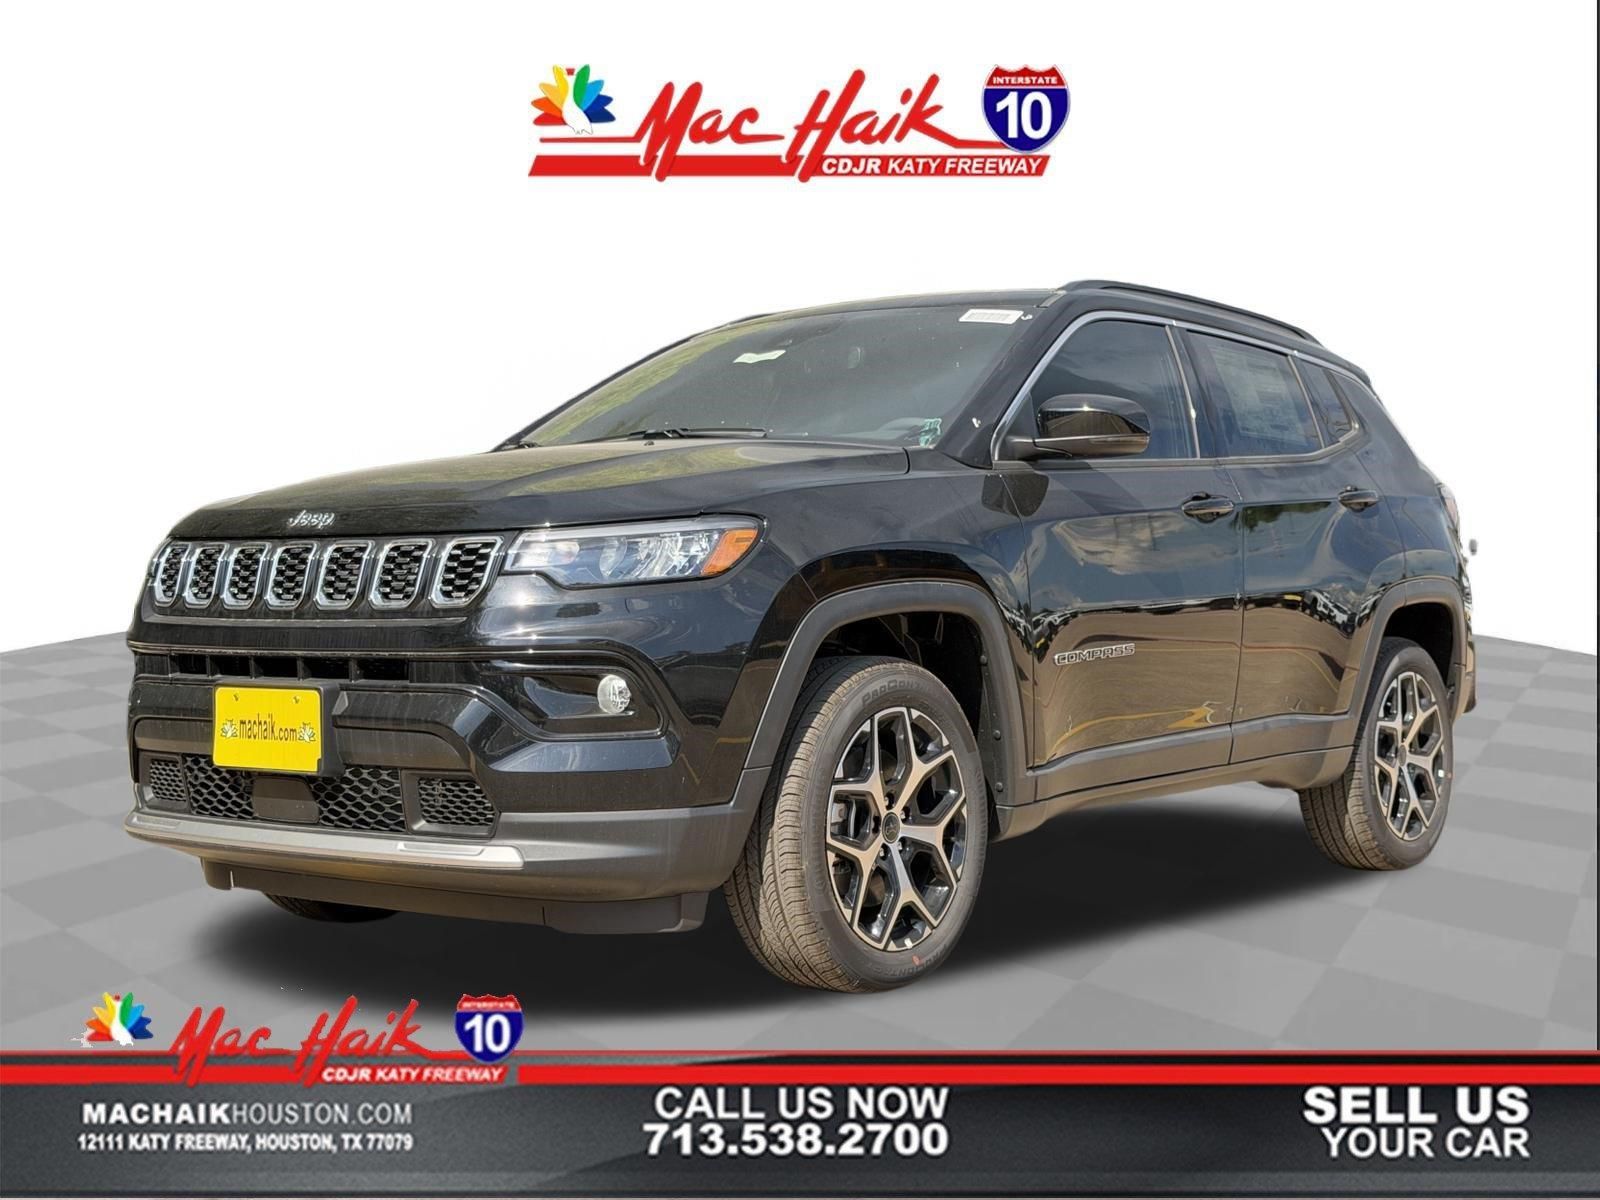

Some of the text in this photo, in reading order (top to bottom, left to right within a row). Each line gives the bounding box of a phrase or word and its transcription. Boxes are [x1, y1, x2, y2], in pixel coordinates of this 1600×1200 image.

[286, 509, 335, 529] Jeep
[1055, 643, 1135, 665] COMPASS
[239, 712, 298, 742] machaik.com
